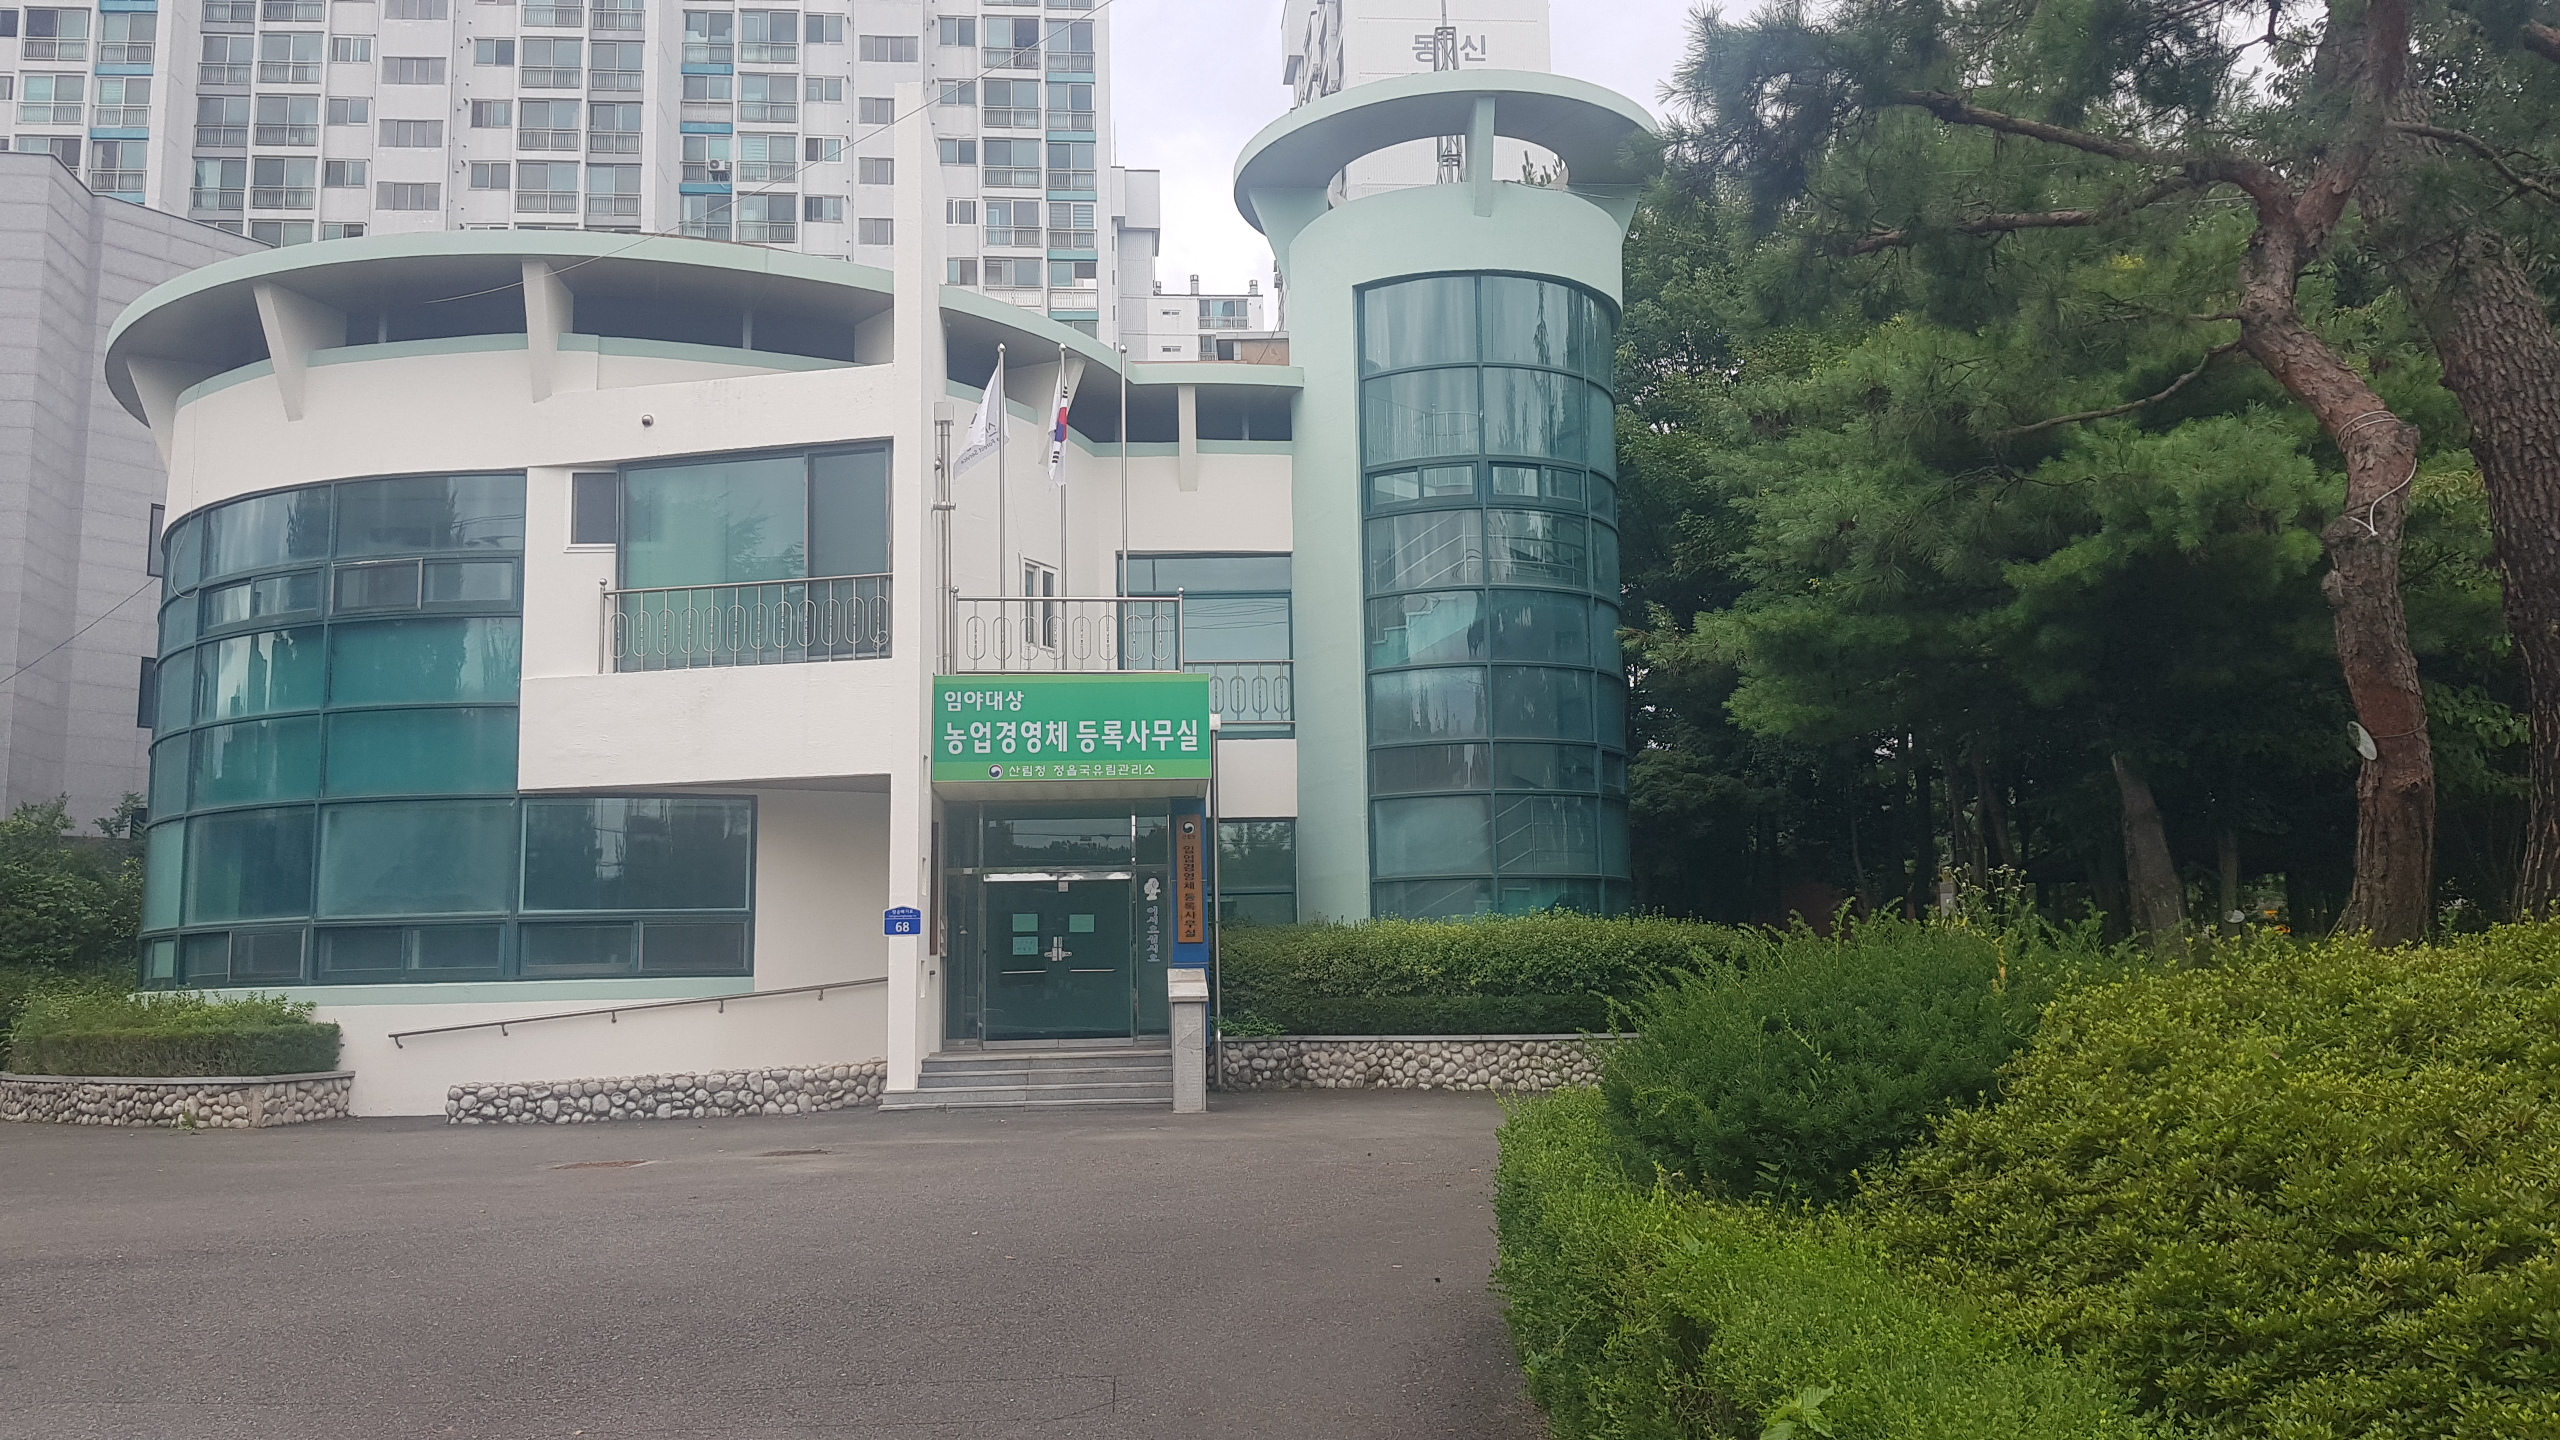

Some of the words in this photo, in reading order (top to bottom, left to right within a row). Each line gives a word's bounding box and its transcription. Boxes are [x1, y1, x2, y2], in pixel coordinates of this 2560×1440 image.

[944, 690, 1024, 711] 임야대상
[944, 720, 1068, 755] 농업경영체
[1076, 719, 1198, 753] 등록사무실
[1008, 764, 1046, 777] 산림청
[1053, 764, 1155, 777] 정읍국유림관리소
[1183, 846, 1194, 889] 임업경영체
[895, 921, 909, 932] 68
[1146, 905, 1160, 961] 어서오십시오
[1184, 893, 1196, 937] 등록사무실
